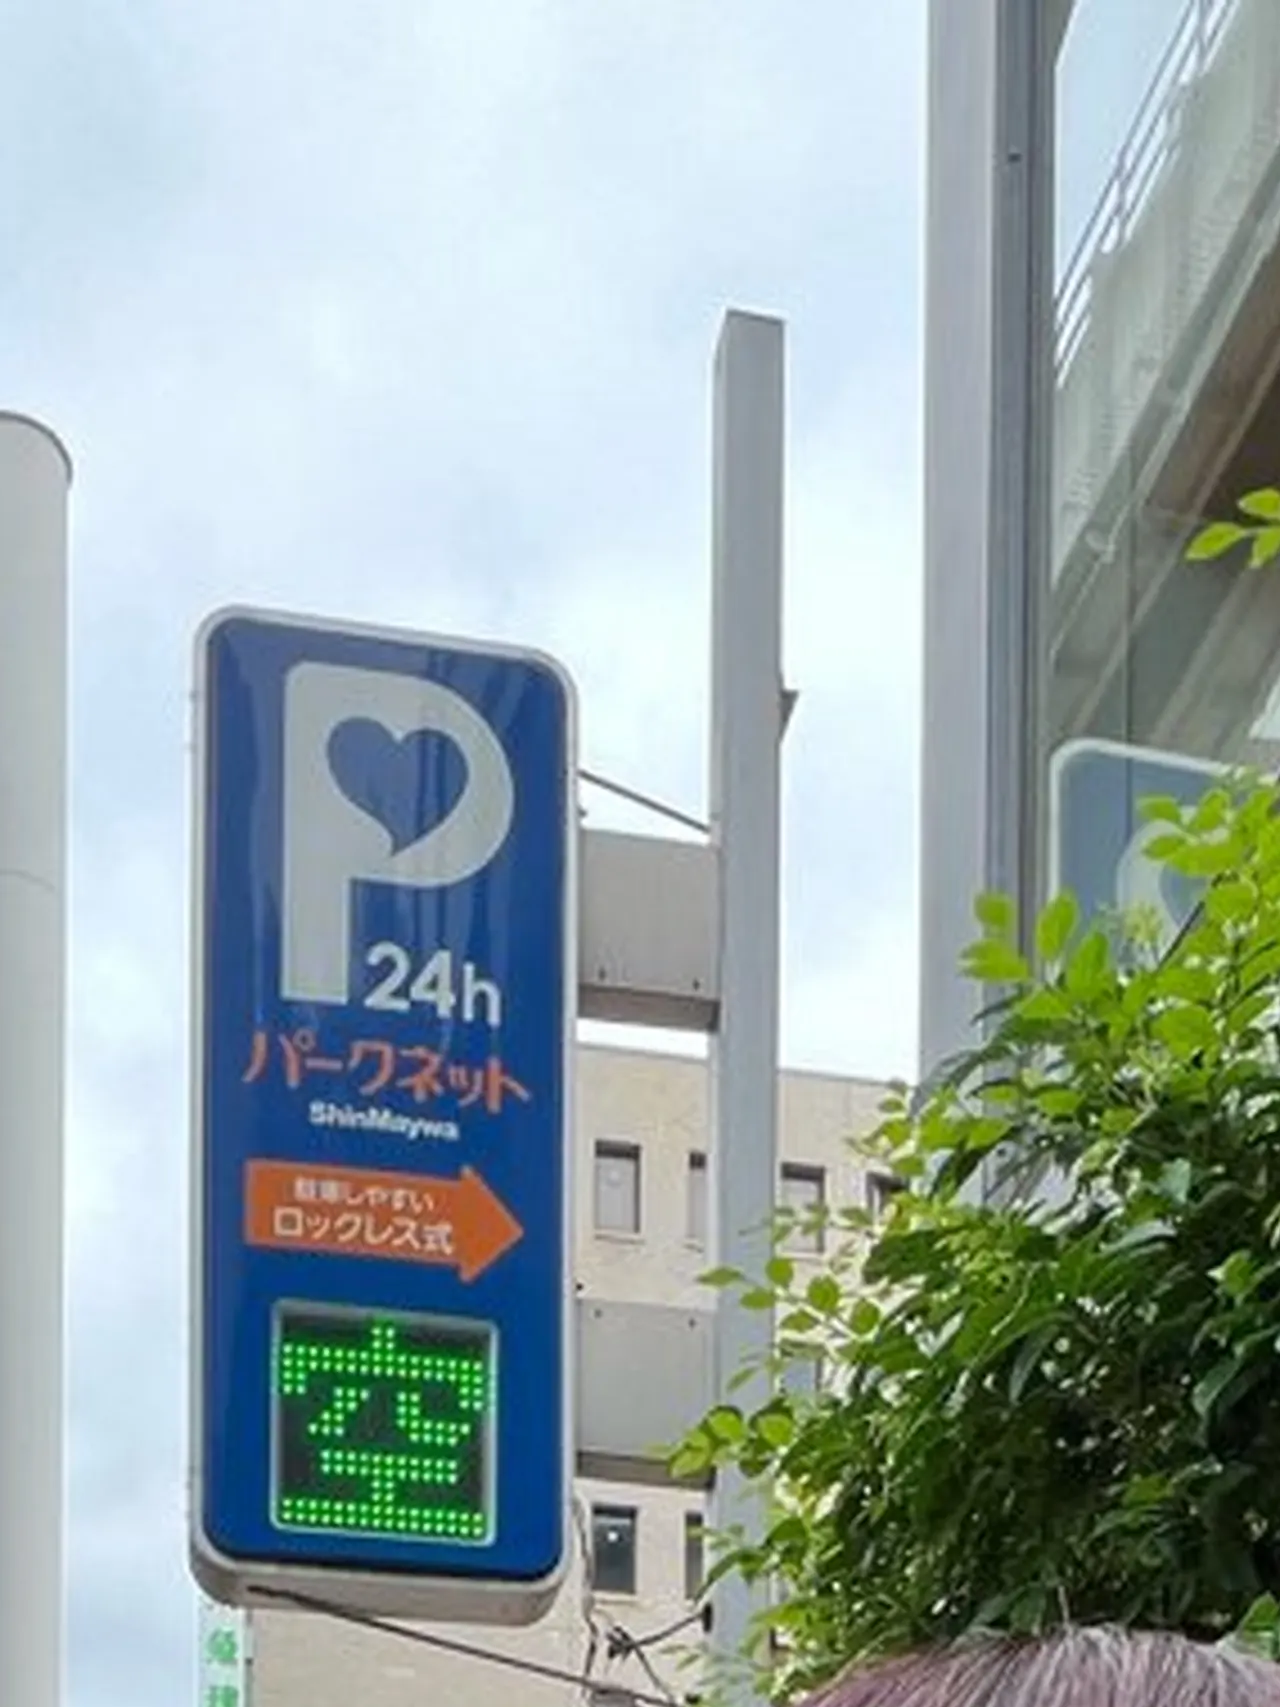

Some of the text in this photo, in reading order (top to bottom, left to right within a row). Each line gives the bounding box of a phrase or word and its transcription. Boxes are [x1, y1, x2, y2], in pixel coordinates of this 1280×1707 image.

[364, 940, 501, 1028] 24h
[241, 1028, 532, 1114] パークネット
[308, 1099, 462, 1141] ShinMaywa
[273, 1205, 455, 1256] ロックレス式
[280, 1322, 486, 1538] 空
